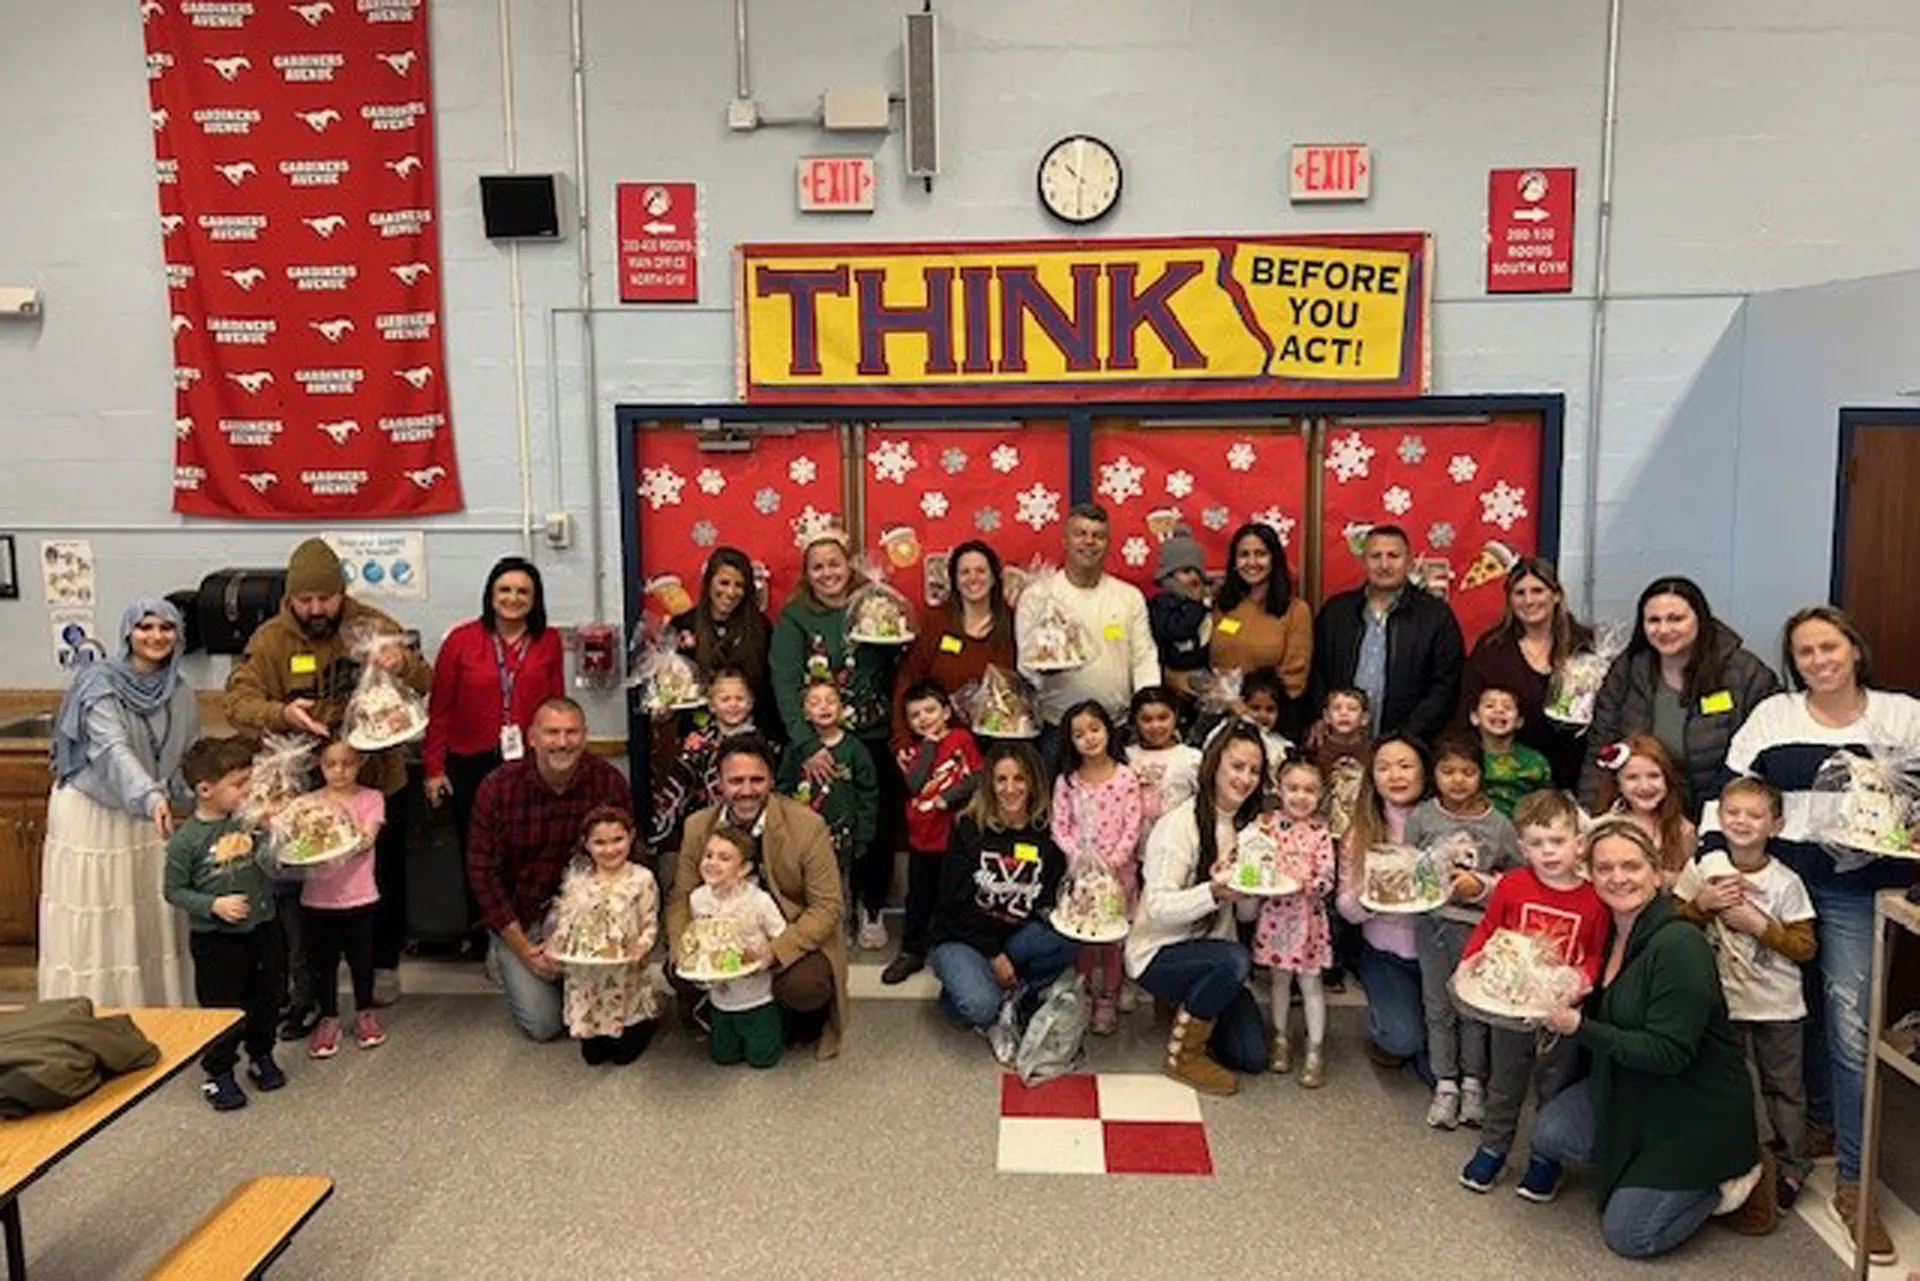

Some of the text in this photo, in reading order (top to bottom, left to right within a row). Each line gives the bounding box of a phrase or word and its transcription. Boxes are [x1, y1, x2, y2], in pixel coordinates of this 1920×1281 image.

[812, 161, 863, 204] EXIT
[1306, 149, 1359, 191] EXIT
[1491, 261, 1569, 274] SOUTH GYM
[1507, 244, 1553, 258] ROOMS
[1251, 256, 1400, 295] BEFORE
[755, 263, 1208, 375] THINK
[1287, 297, 1359, 329] YOU
[1279, 336, 1364, 367] ACT!
